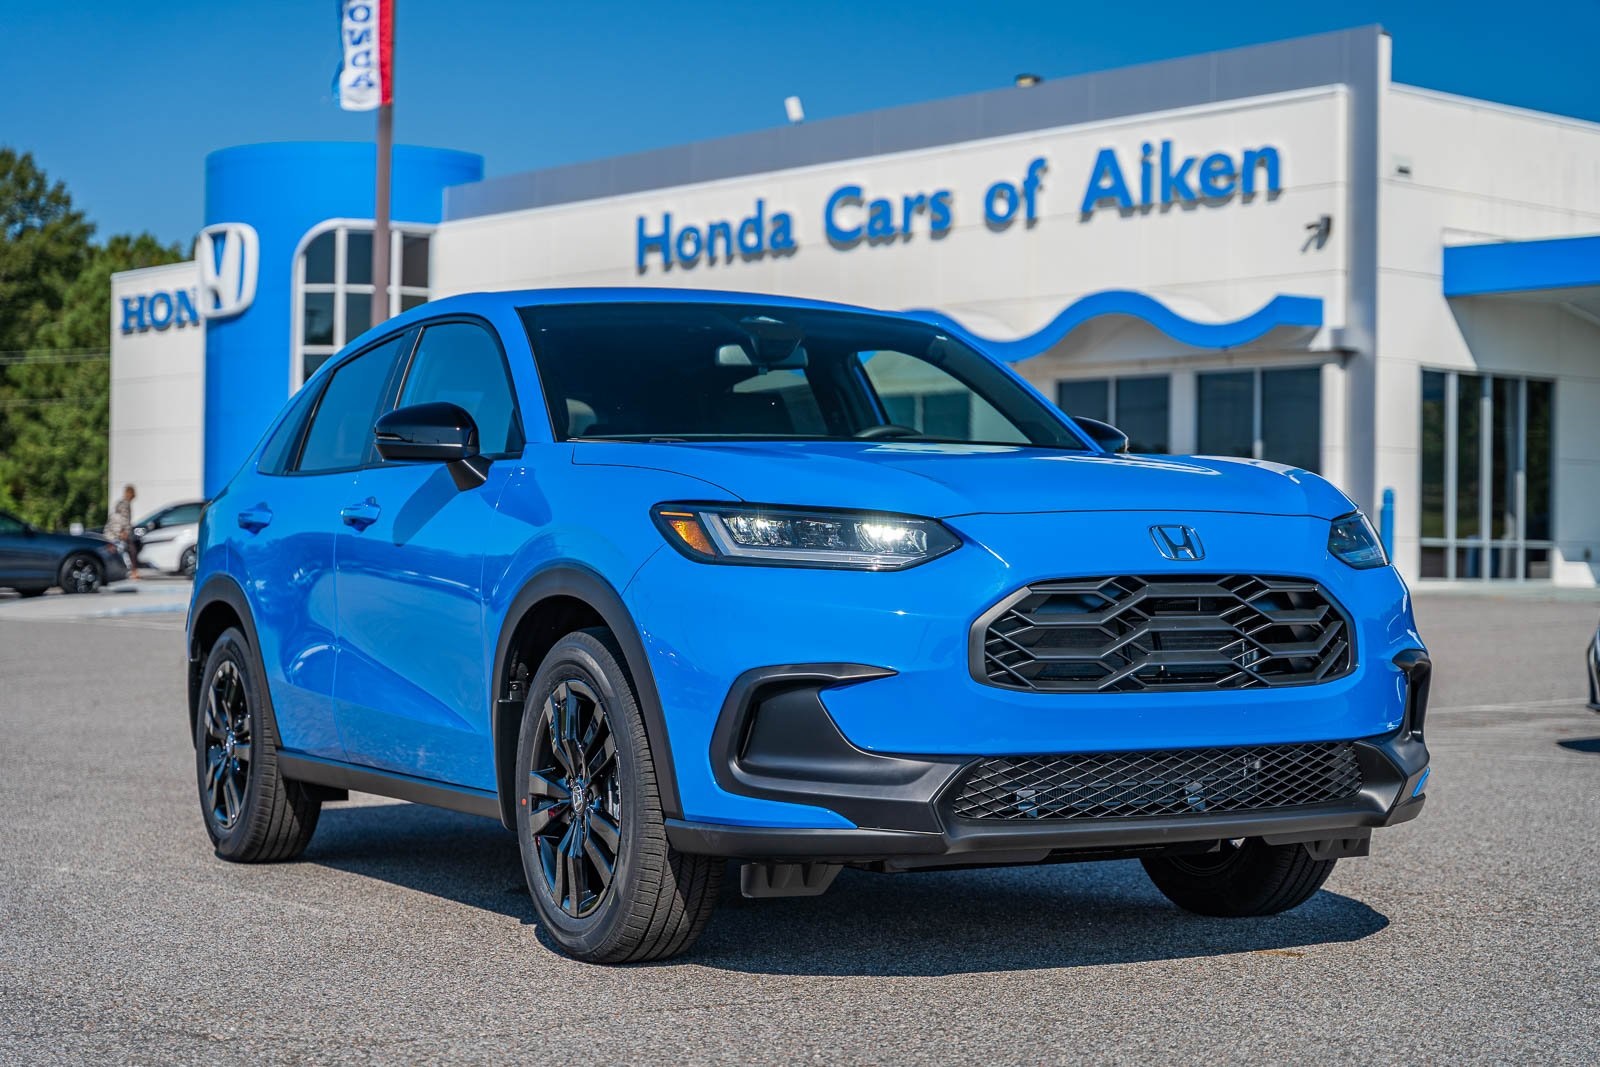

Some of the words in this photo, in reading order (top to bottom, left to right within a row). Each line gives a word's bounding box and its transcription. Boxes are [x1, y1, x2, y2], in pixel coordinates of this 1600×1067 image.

[636, 197, 797, 270] Honda
[824, 185, 953, 246] Cars
[984, 157, 1048, 225] of
[1080, 139, 1281, 215] Aiken
